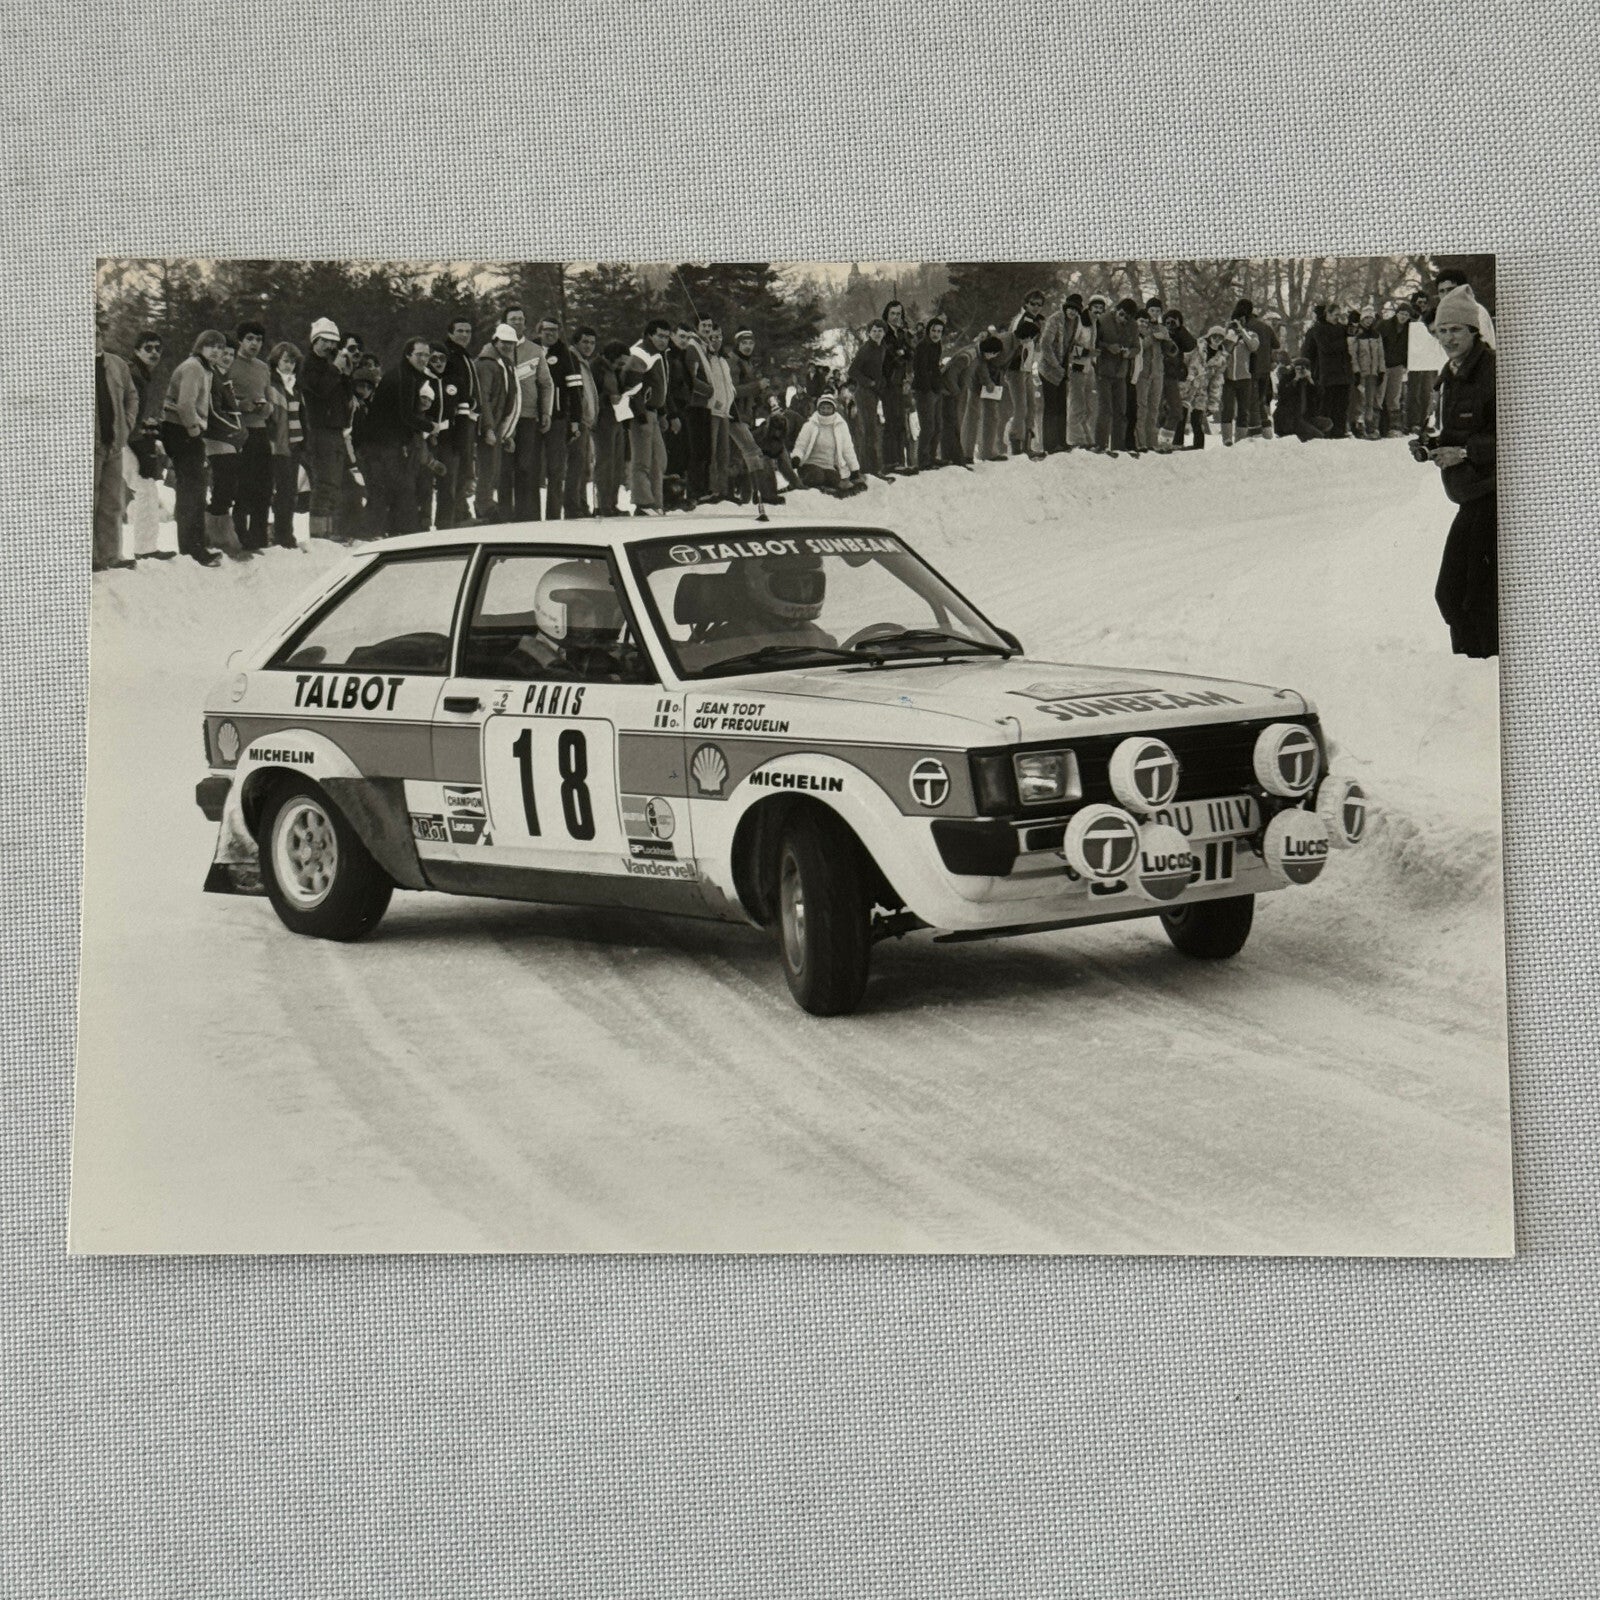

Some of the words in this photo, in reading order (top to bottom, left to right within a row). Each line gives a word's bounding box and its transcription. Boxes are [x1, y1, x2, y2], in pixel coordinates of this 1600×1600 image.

[699, 539, 800, 560] TALBOT
[805, 536, 901, 554] SUNBEAM
[294, 675, 405, 711] TALBOT
[522, 684, 586, 716] PARIS
[695, 701, 729, 715] JEAN
[732, 703, 765, 716] TODT
[1035, 690, 1244, 721] SUNBEAM
[693, 716, 718, 730] GUY
[720, 717, 789, 733] FREQUELIN
[249, 748, 315, 764] MICHELIN
[512, 728, 596, 842] 18
[749, 771, 844, 793] MICHELIN
[1284, 835, 1329, 857] Lucas
[621, 857, 696, 879] Vandervell
[1140, 851, 1192, 873] Lucas
